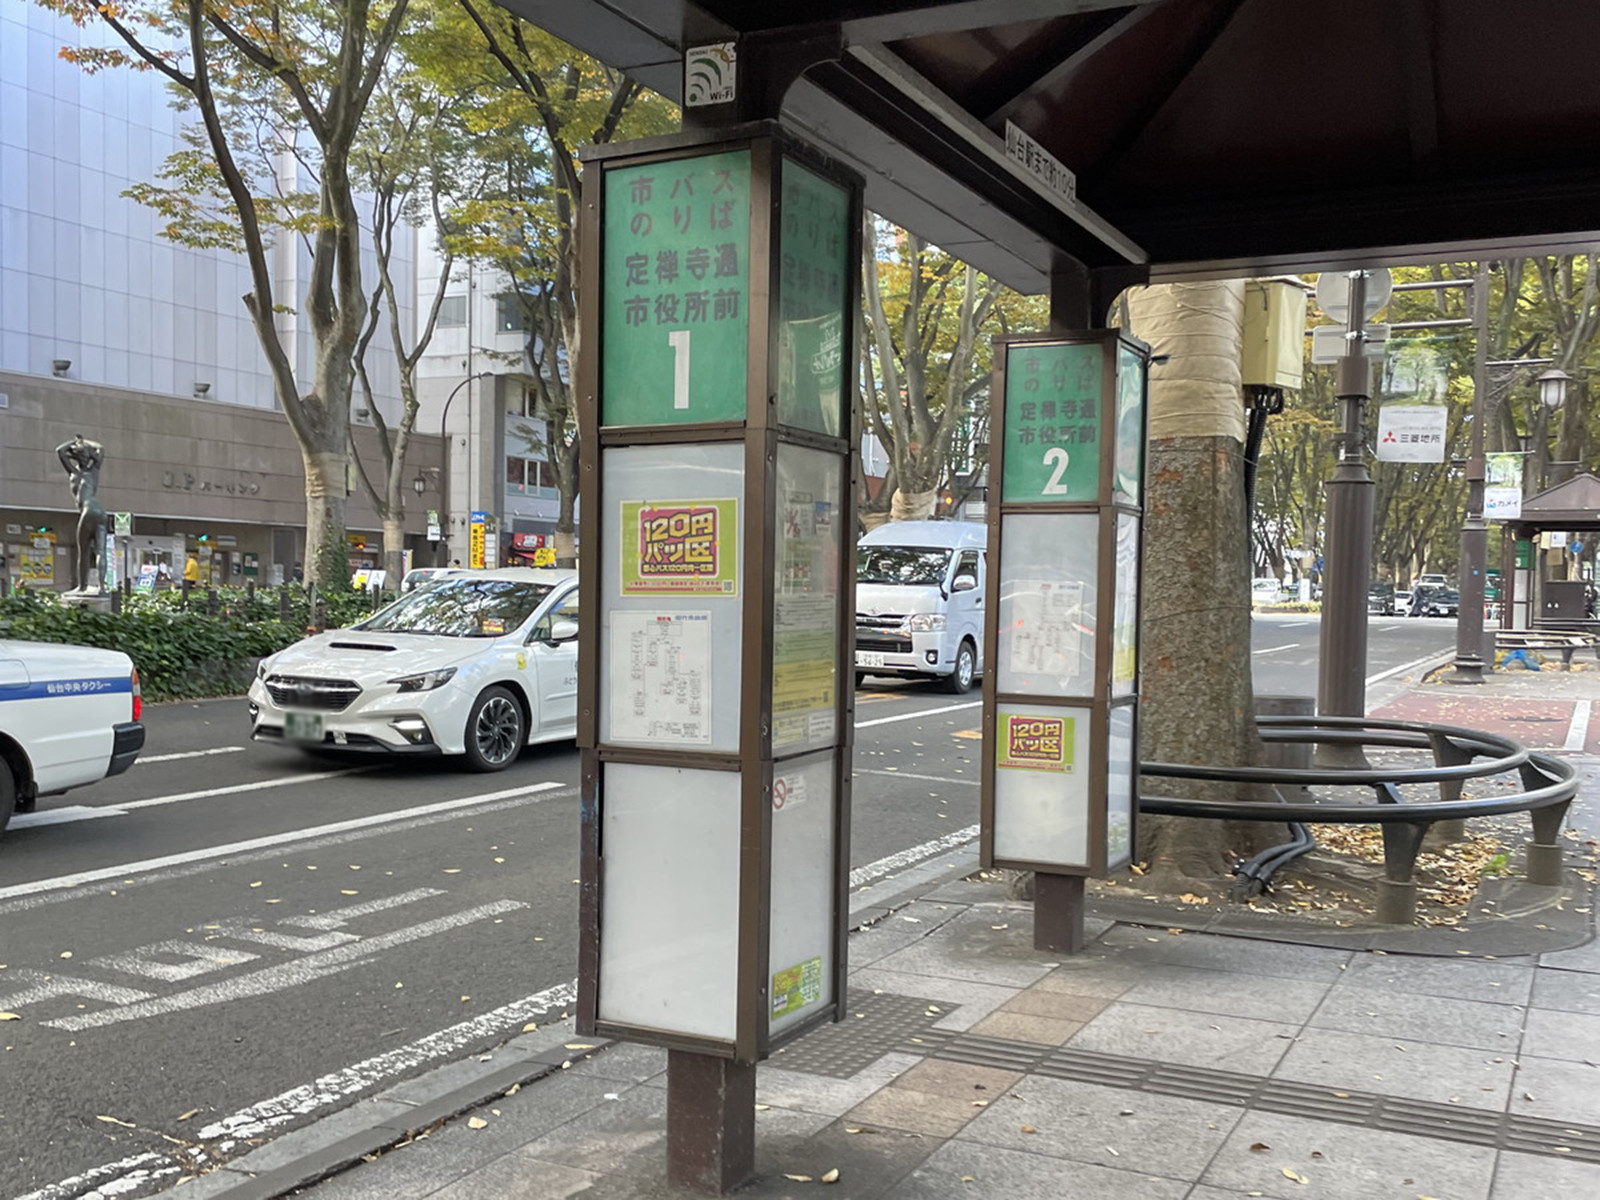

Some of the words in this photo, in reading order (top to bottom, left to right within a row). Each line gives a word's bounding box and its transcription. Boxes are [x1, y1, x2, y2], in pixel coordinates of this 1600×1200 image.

[710, 90, 734, 100] Wi-Fi
[629, 170, 734, 206] 市バス
[630, 201, 735, 236] のりば
[625, 243, 738, 287] 定禅寺通
[623, 288, 741, 327] 市役所前
[669, 330, 691, 409] 1
[1020, 399, 1096, 421] 定禅寺通
[1019, 425, 1096, 445] 市役所前
[1400, 433, 1441, 443] 三菱地所
[1041, 447, 1069, 495] 2
[643, 511, 714, 542] 120円
[47, 680, 111, 693] 仙台中央タクシー
[1012, 722, 1060, 738] 120円
